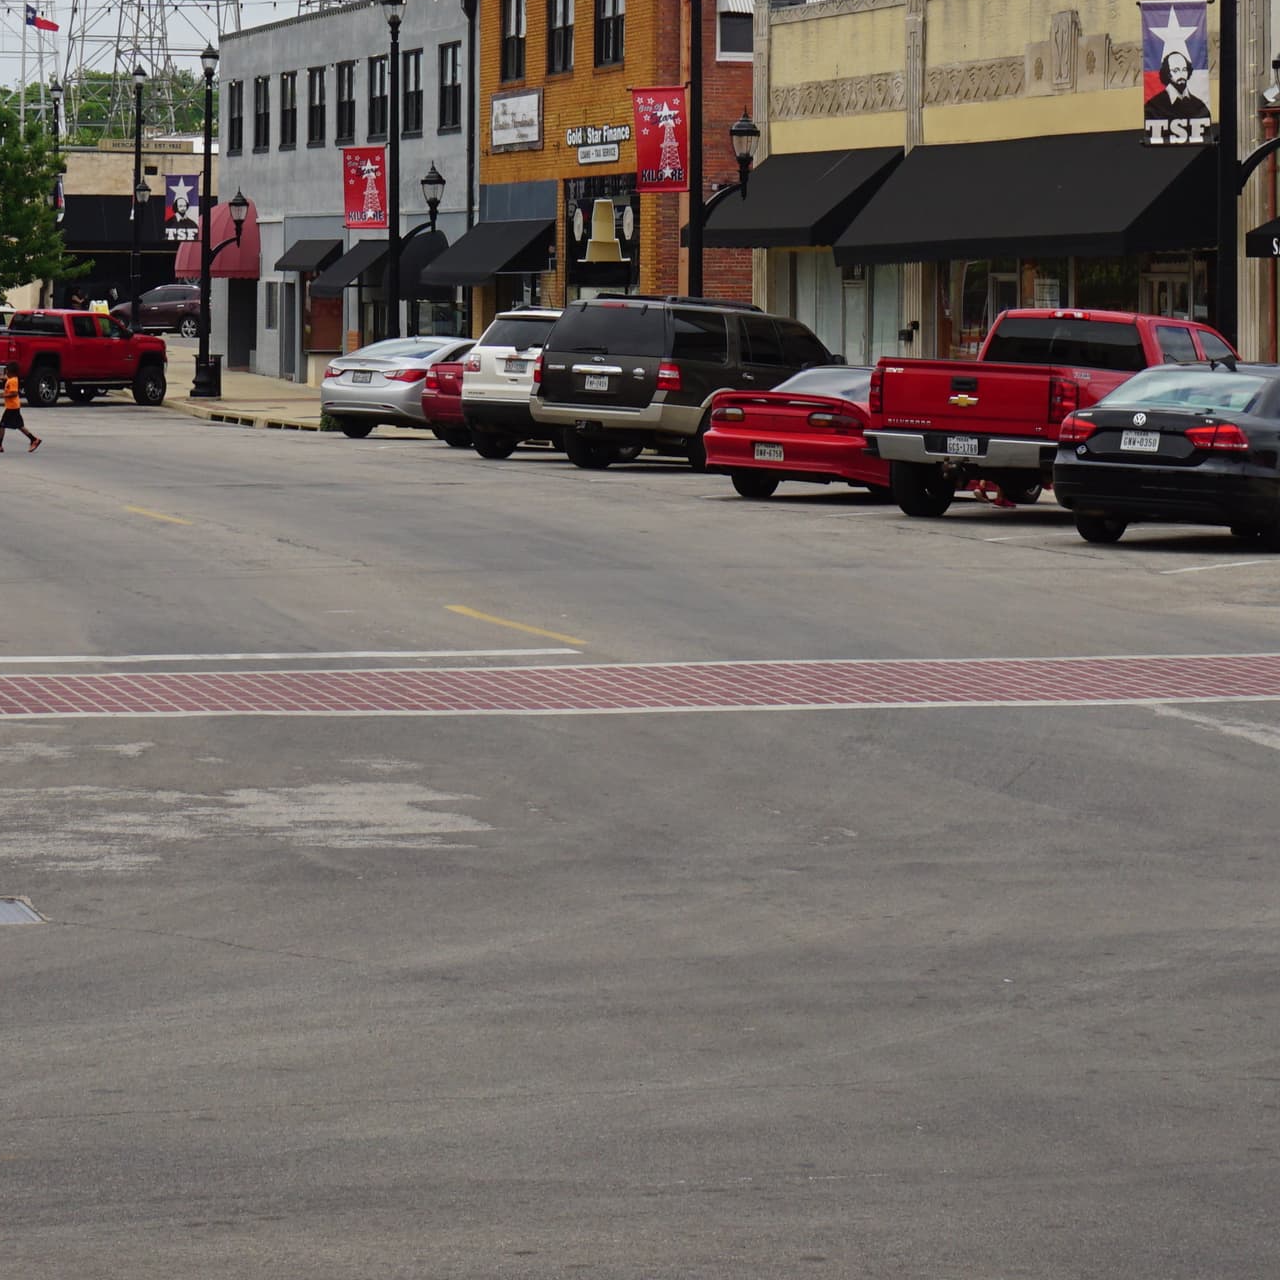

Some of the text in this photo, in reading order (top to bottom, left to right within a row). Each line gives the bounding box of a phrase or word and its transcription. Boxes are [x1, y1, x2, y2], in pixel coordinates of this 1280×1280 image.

[567, 125, 630, 146] Gold Star Finance
[1145, 118, 1211, 144] TSF
[165, 227, 199, 240] TSF
